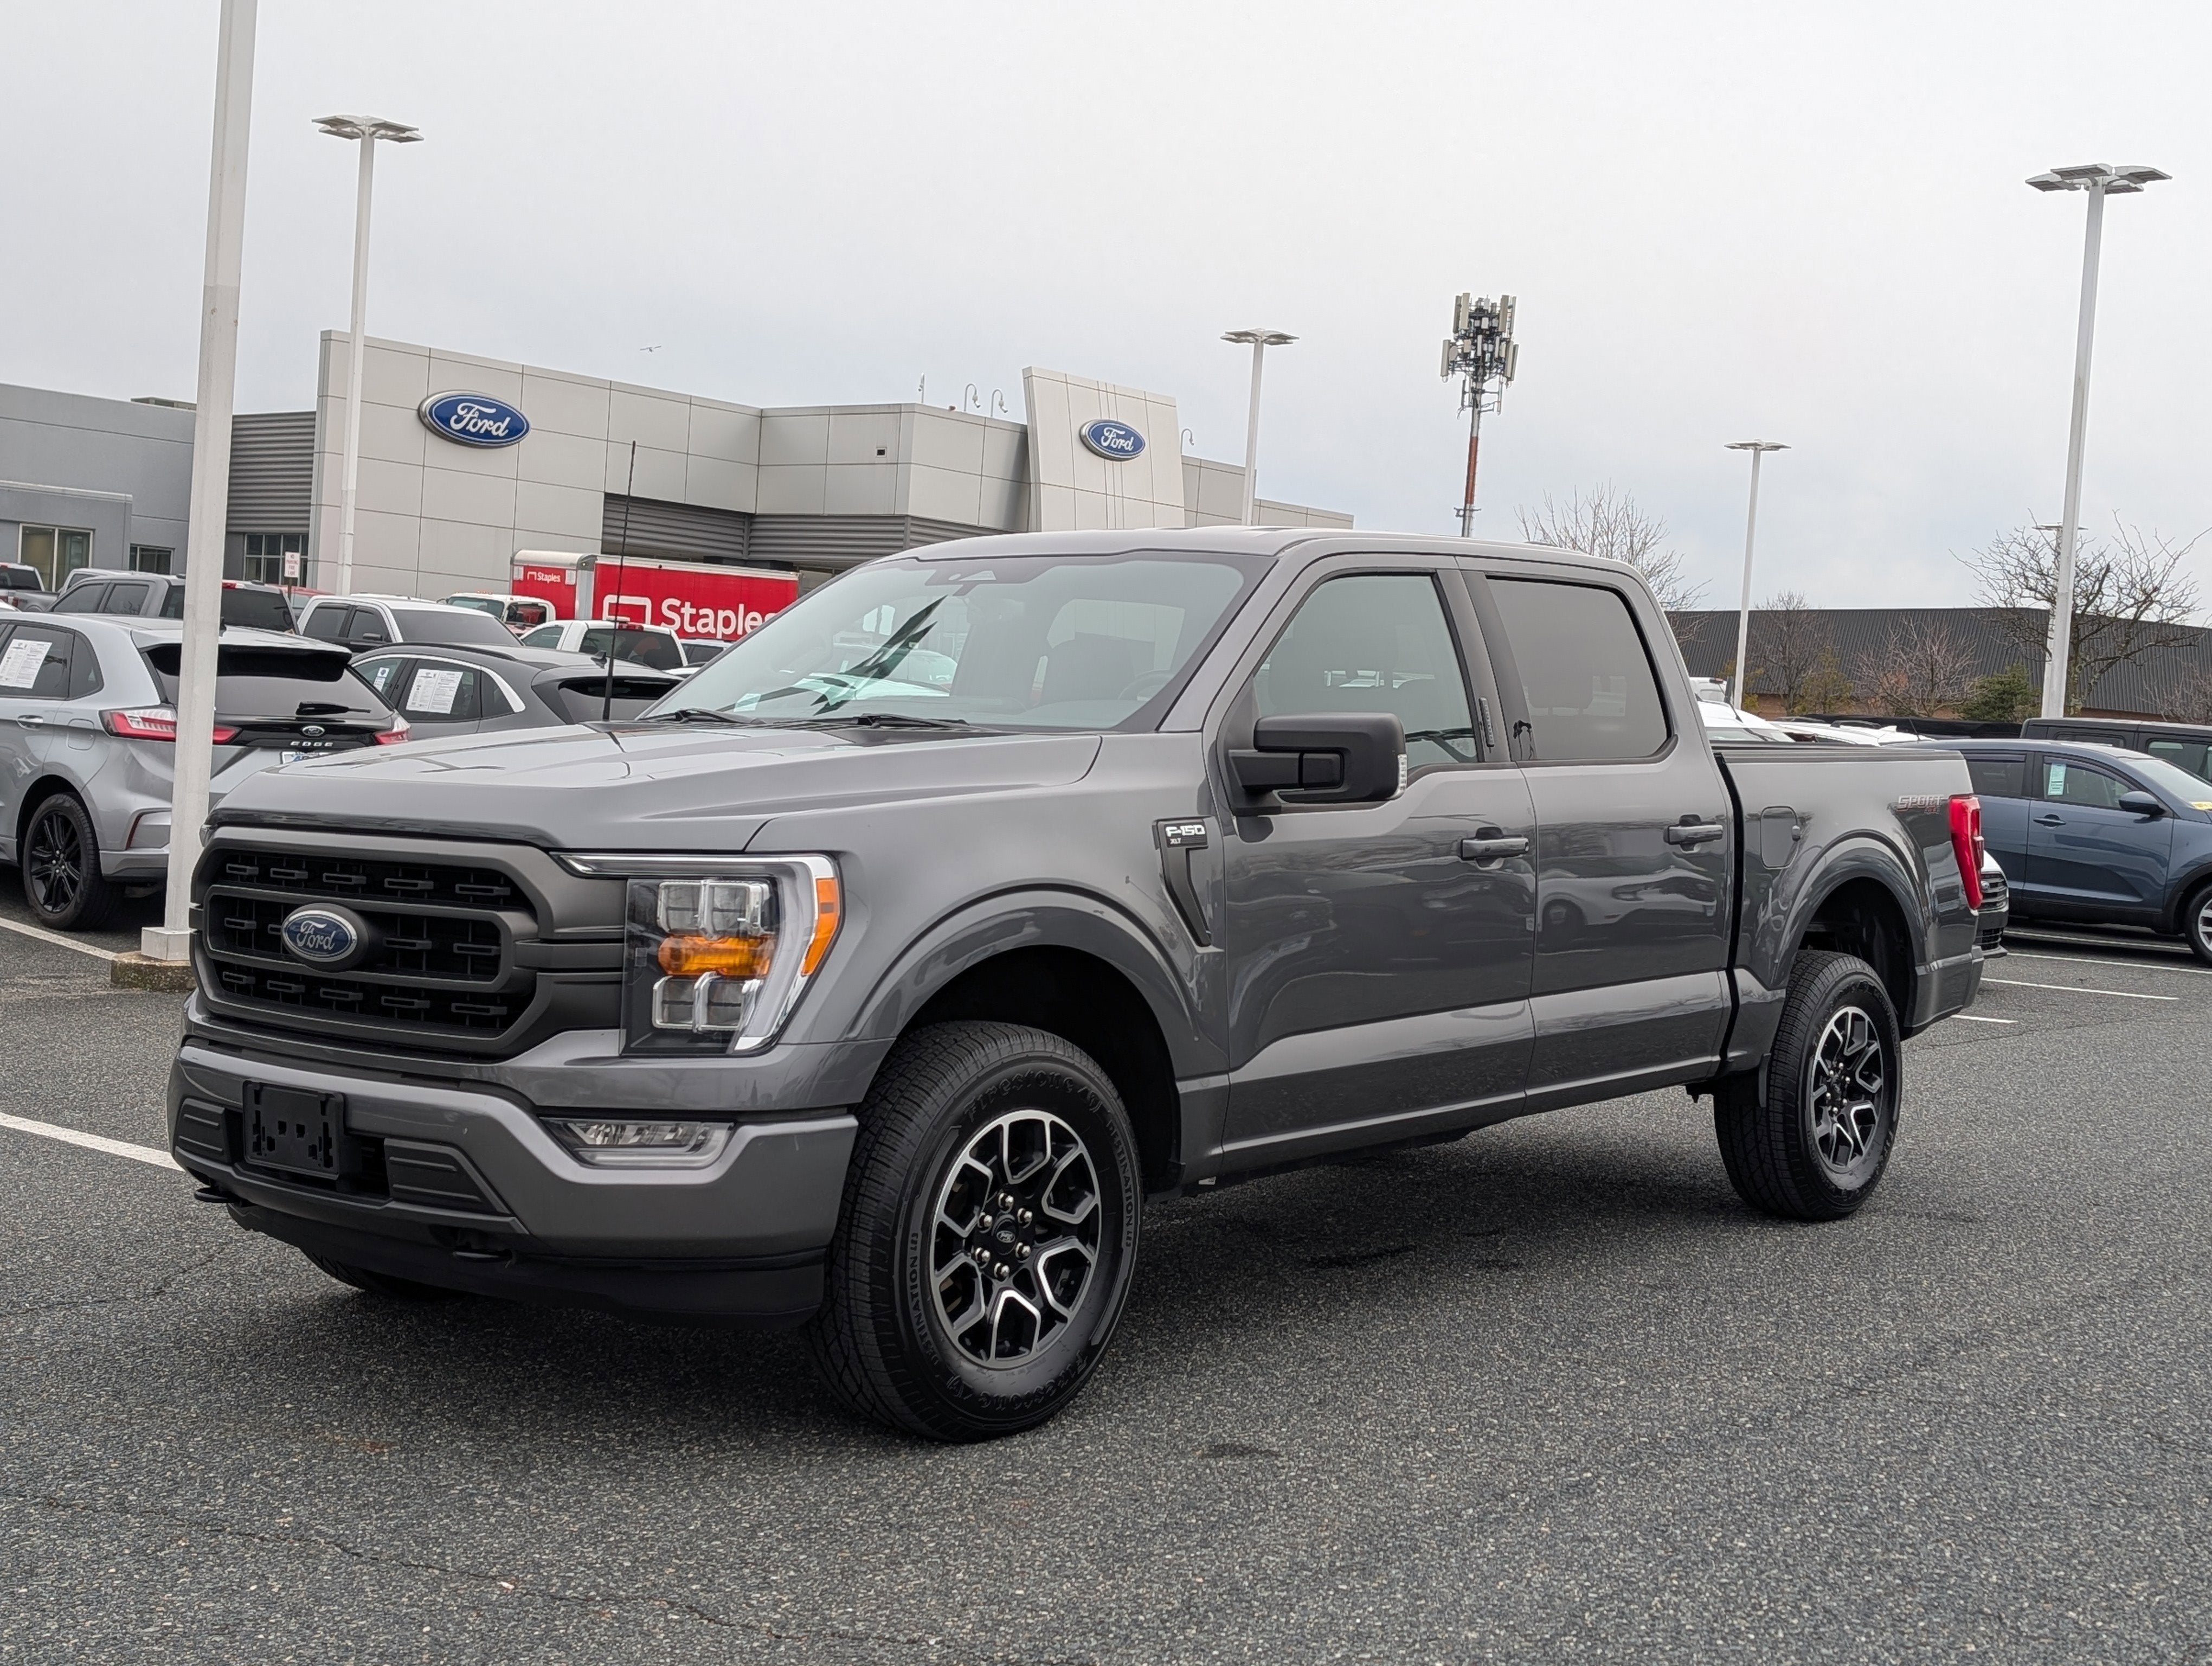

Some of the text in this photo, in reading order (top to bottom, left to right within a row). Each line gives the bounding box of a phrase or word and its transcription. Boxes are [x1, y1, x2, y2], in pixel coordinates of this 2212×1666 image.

[450, 402, 511, 437] Ford
[1101, 427, 1134, 451] Ford
[537, 571, 561, 584] Staples
[1896, 795, 1944, 812] SPORT
[1166, 825, 1206, 837] F-150
[296, 920, 336, 950] Ford
[1106, 1120, 1134, 1227] DESTINATION
[909, 1255, 941, 1366] DESTINATION
